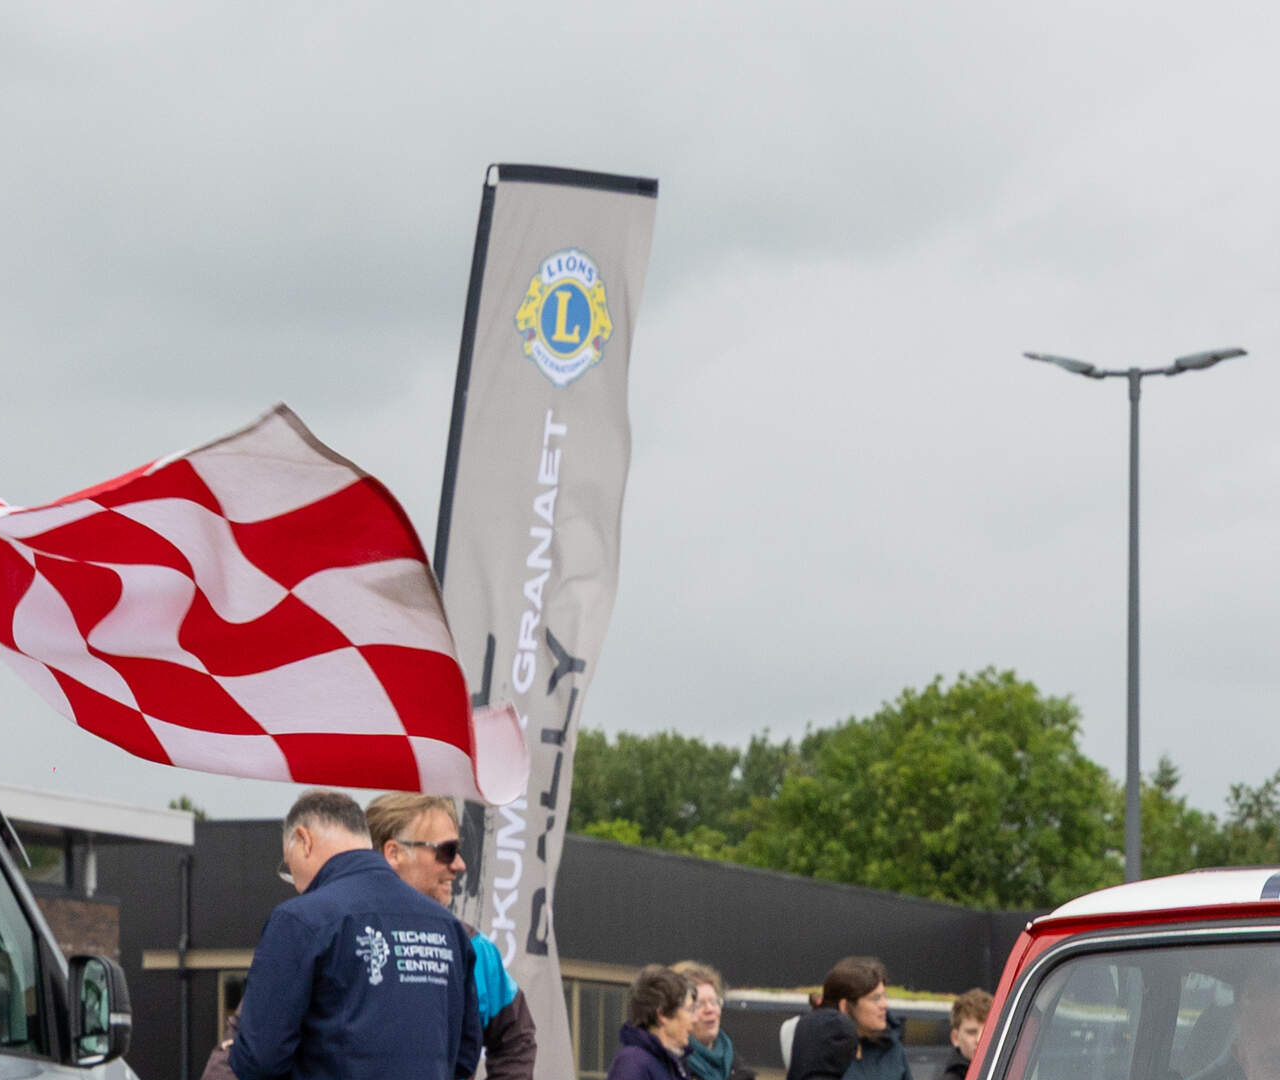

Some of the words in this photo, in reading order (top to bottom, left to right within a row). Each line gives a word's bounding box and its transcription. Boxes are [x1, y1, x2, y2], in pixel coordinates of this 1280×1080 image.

[546, 255, 595, 283] LIONS
[552, 290, 580, 344] L
[512, 409, 568, 693] GRANAET
[391, 930, 448, 946] TECHNIEK
[397, 959, 449, 974] CENTRUM
